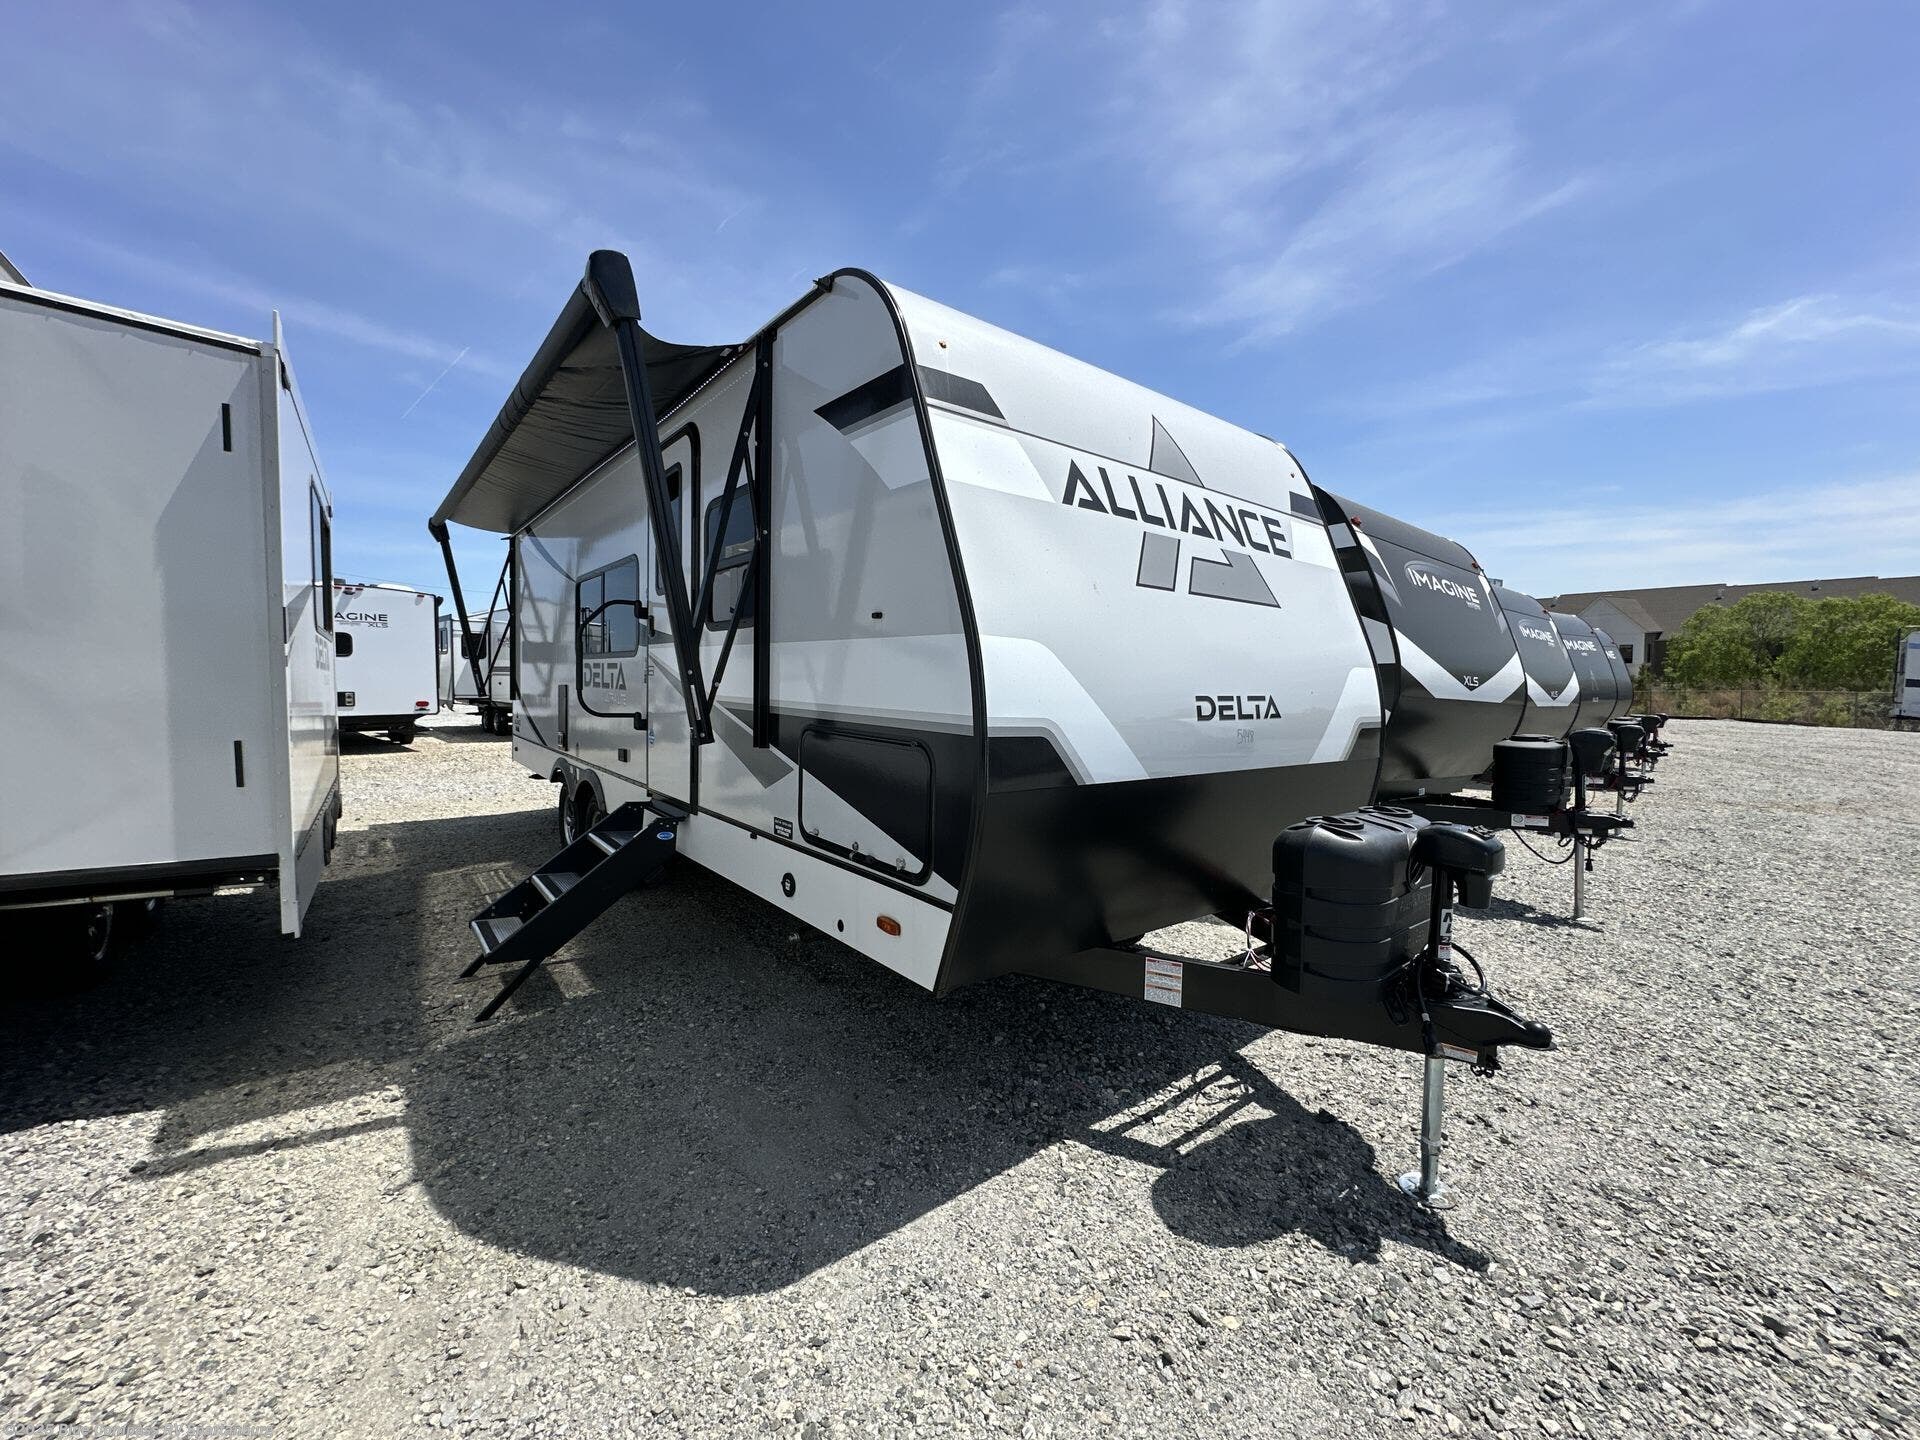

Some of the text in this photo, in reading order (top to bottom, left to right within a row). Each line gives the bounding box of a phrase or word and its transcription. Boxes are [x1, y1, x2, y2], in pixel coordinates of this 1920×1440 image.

[1062, 458, 1293, 560] ALLIANCE
[1407, 567, 1480, 604] IMAGINE
[334, 611, 388, 622] AGINE
[1519, 625, 1555, 643] IMAGINE
[583, 662, 627, 691] DELTA
[1463, 675, 1480, 687] XLS
[1195, 695, 1282, 722] DELTA
